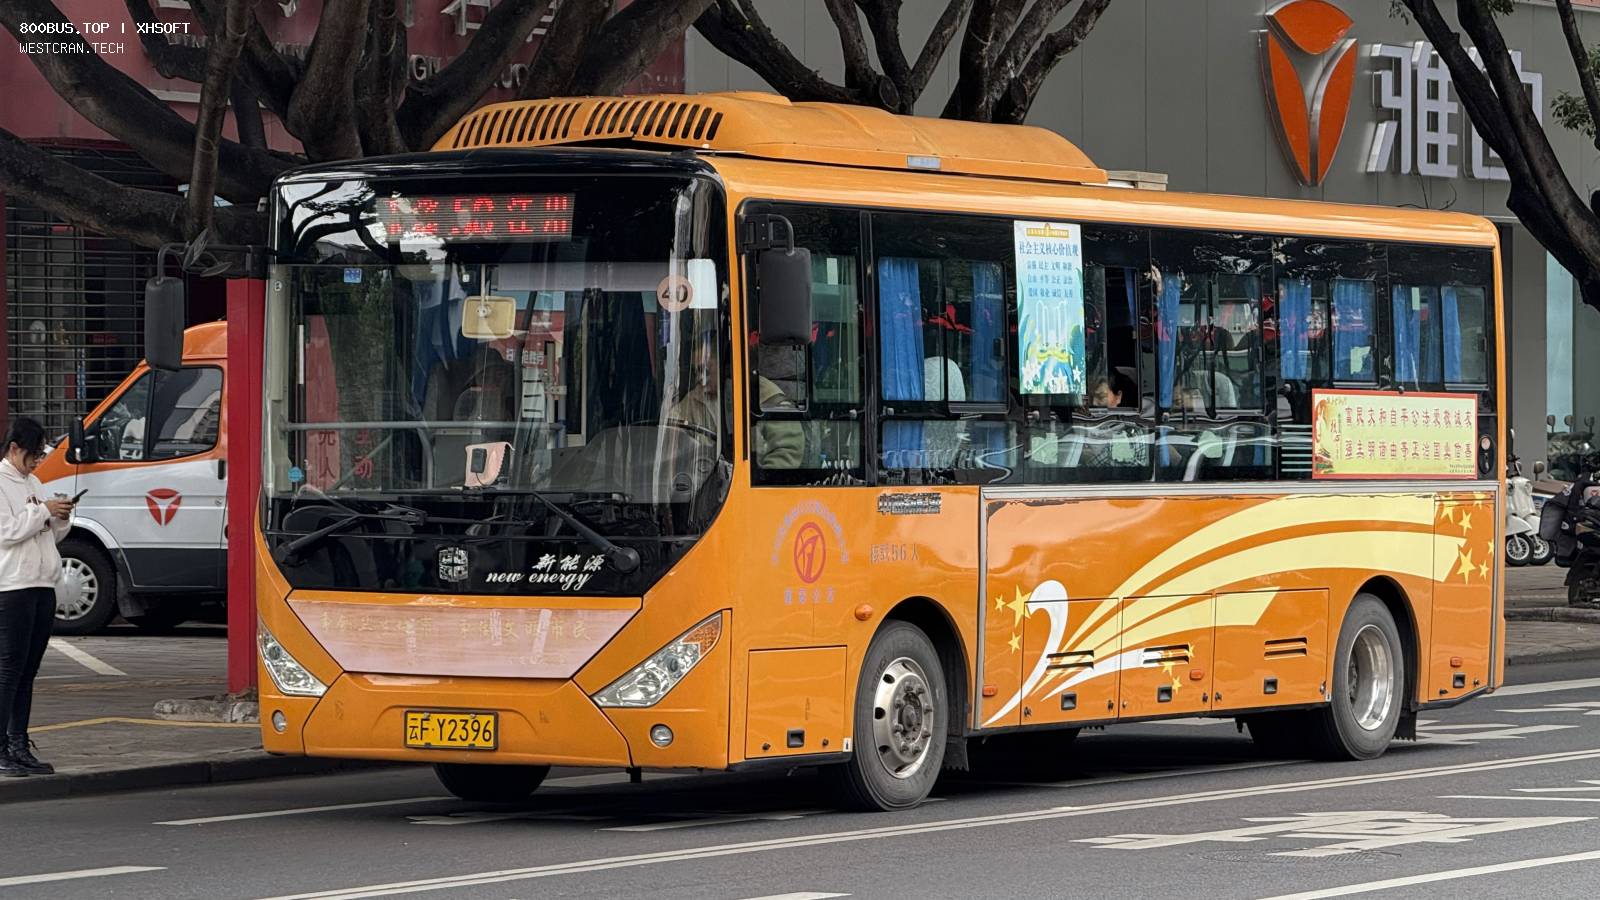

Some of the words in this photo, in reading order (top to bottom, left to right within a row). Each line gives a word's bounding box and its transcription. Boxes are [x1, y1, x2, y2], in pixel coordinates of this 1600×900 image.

[532, 553, 605, 571] 新能源
[485, 571, 525, 583] new
[528, 571, 593, 591] energy
